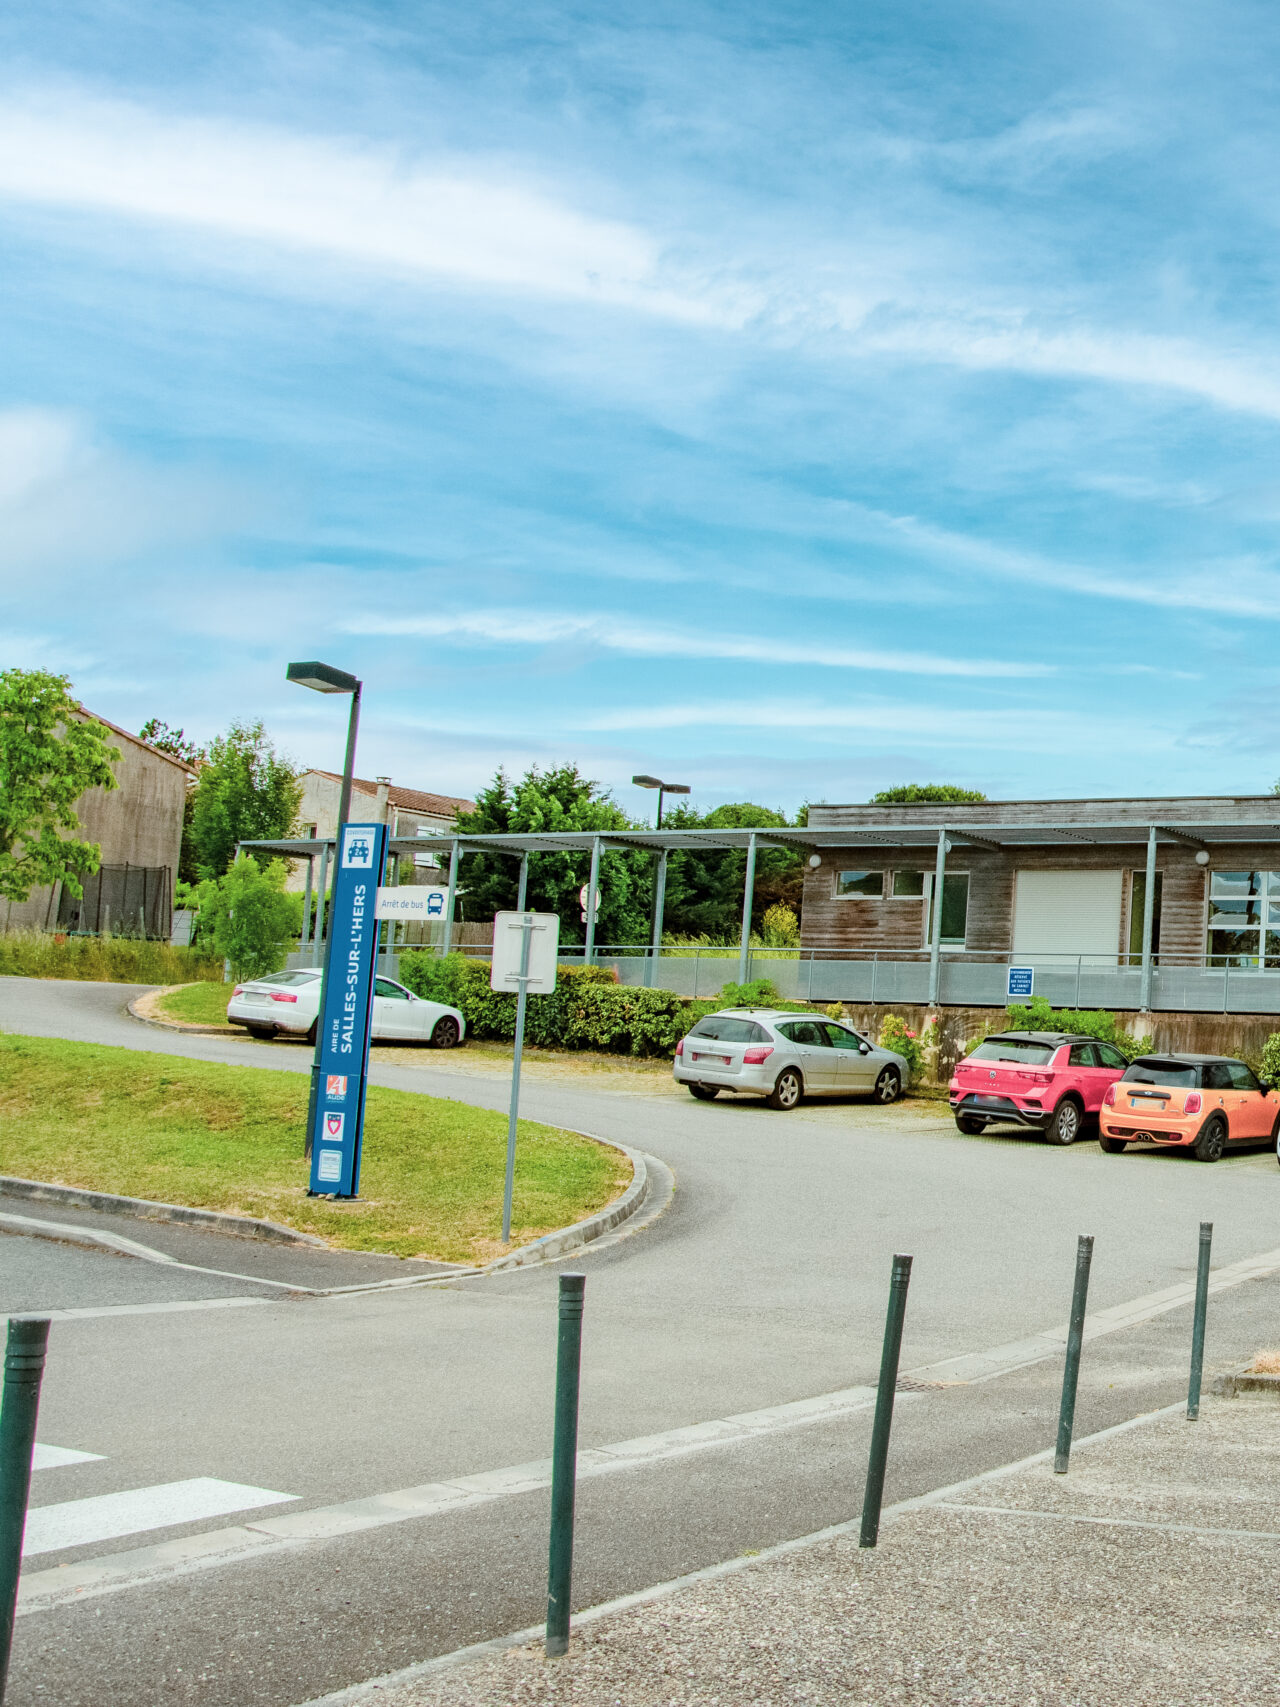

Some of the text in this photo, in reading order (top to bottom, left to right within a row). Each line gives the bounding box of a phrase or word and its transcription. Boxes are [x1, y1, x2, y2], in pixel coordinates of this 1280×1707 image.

[382, 900, 423, 908] Arrêt de bus
[331, 1018, 340, 1053] AIRE DE
